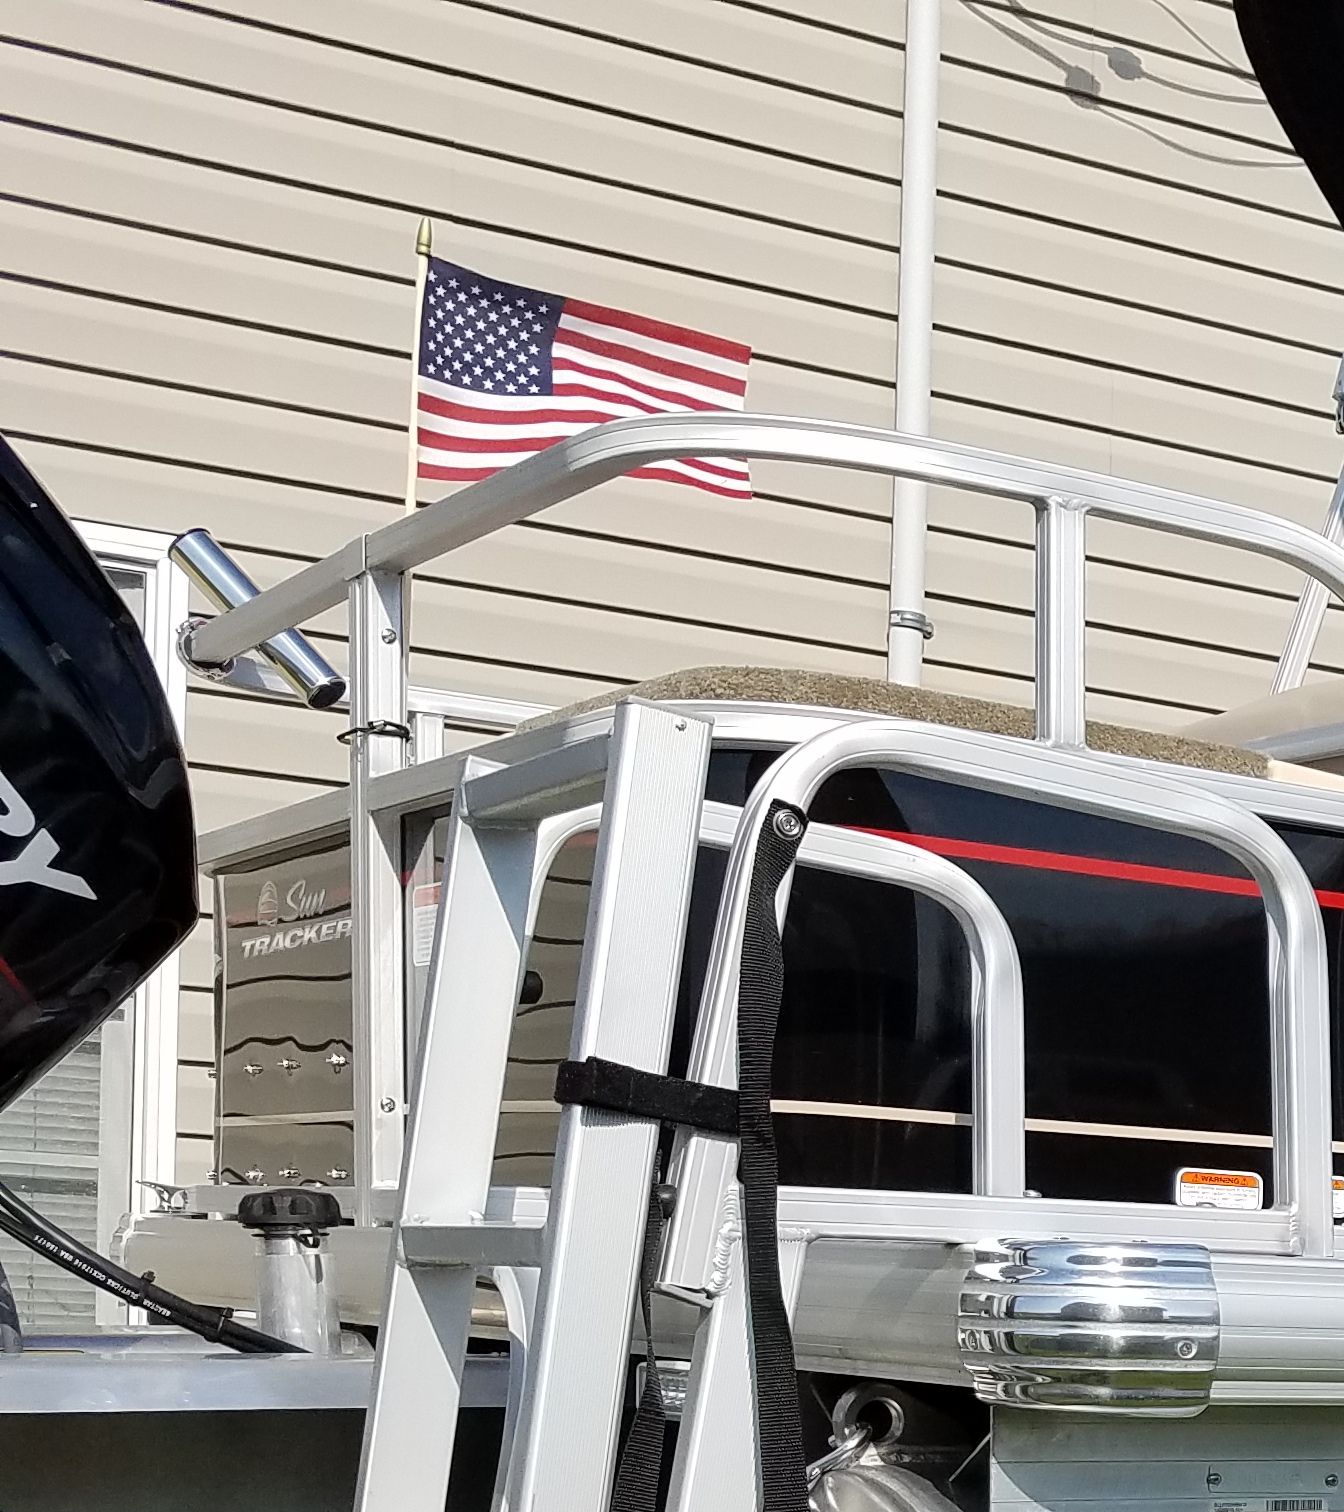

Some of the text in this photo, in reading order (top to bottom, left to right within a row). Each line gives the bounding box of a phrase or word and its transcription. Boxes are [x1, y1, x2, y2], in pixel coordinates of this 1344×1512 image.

[279, 879, 327, 922] Sun
[240, 917, 353, 959] TRACKER
[1201, 1175, 1240, 1185] WARNING
